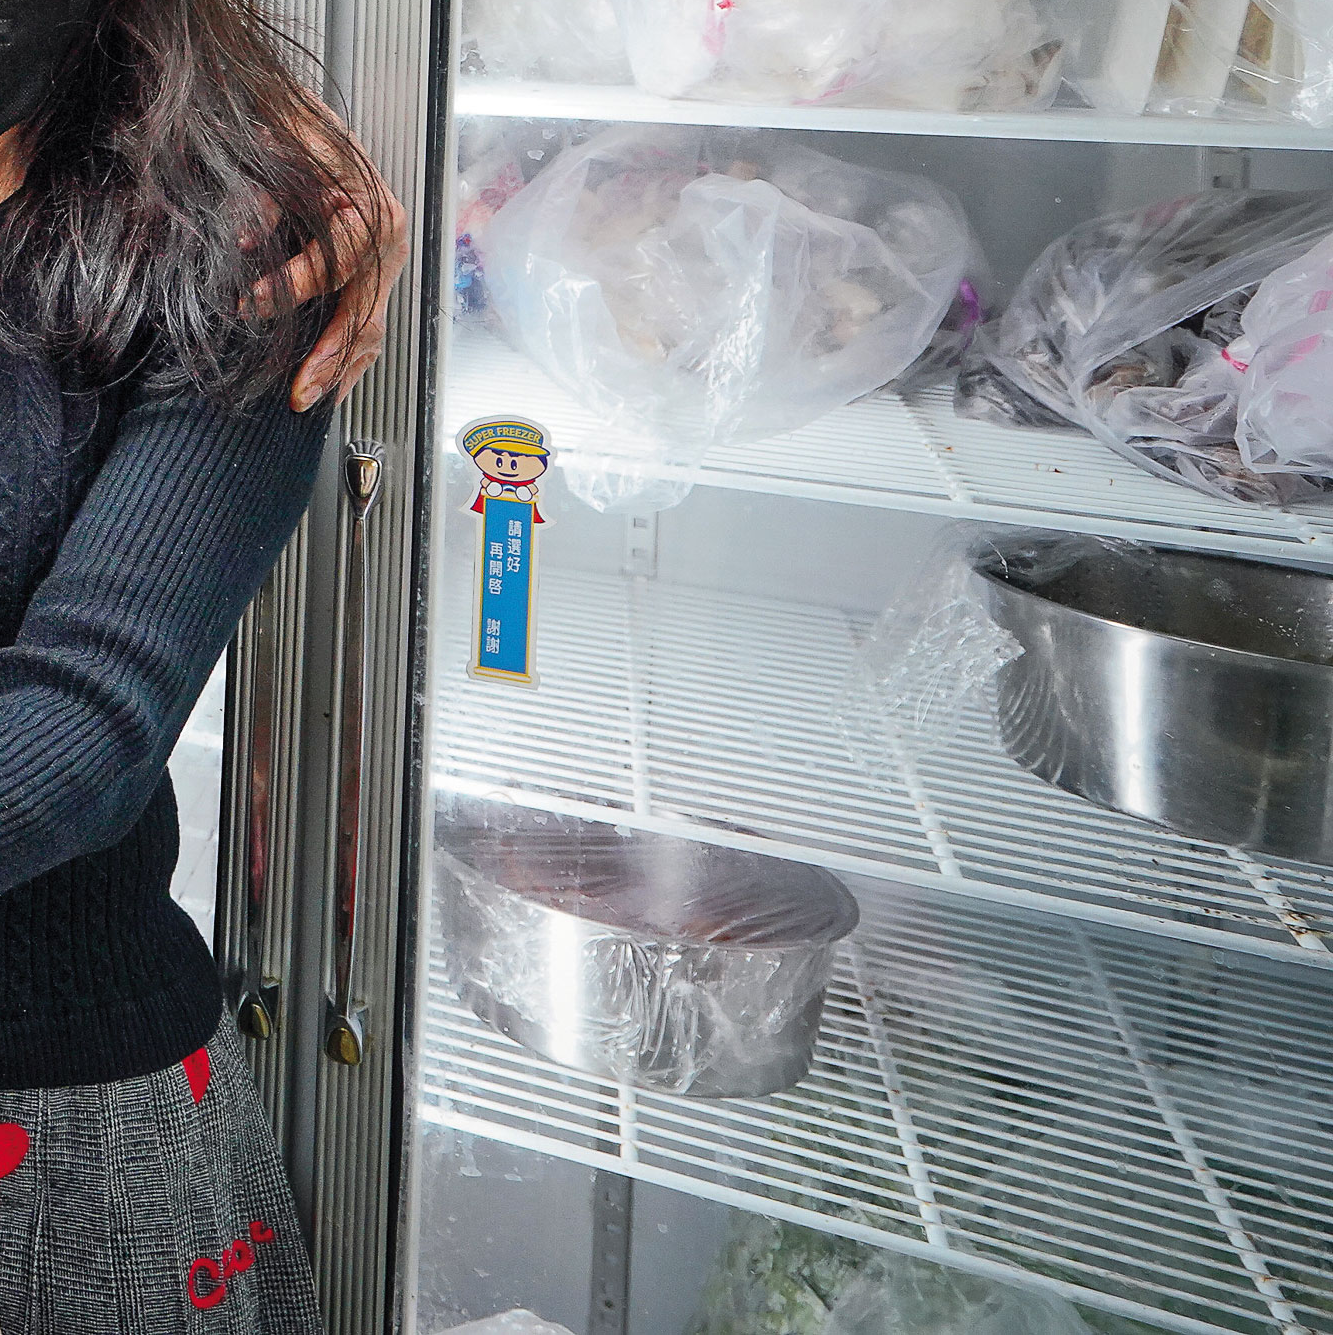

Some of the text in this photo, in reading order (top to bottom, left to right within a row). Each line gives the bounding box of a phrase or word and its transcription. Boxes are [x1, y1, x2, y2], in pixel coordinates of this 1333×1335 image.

[464, 427, 541, 450] SUPER FREEZER
[506, 519, 523, 573] 請選好
[485, 618, 501, 654] 謝謝
